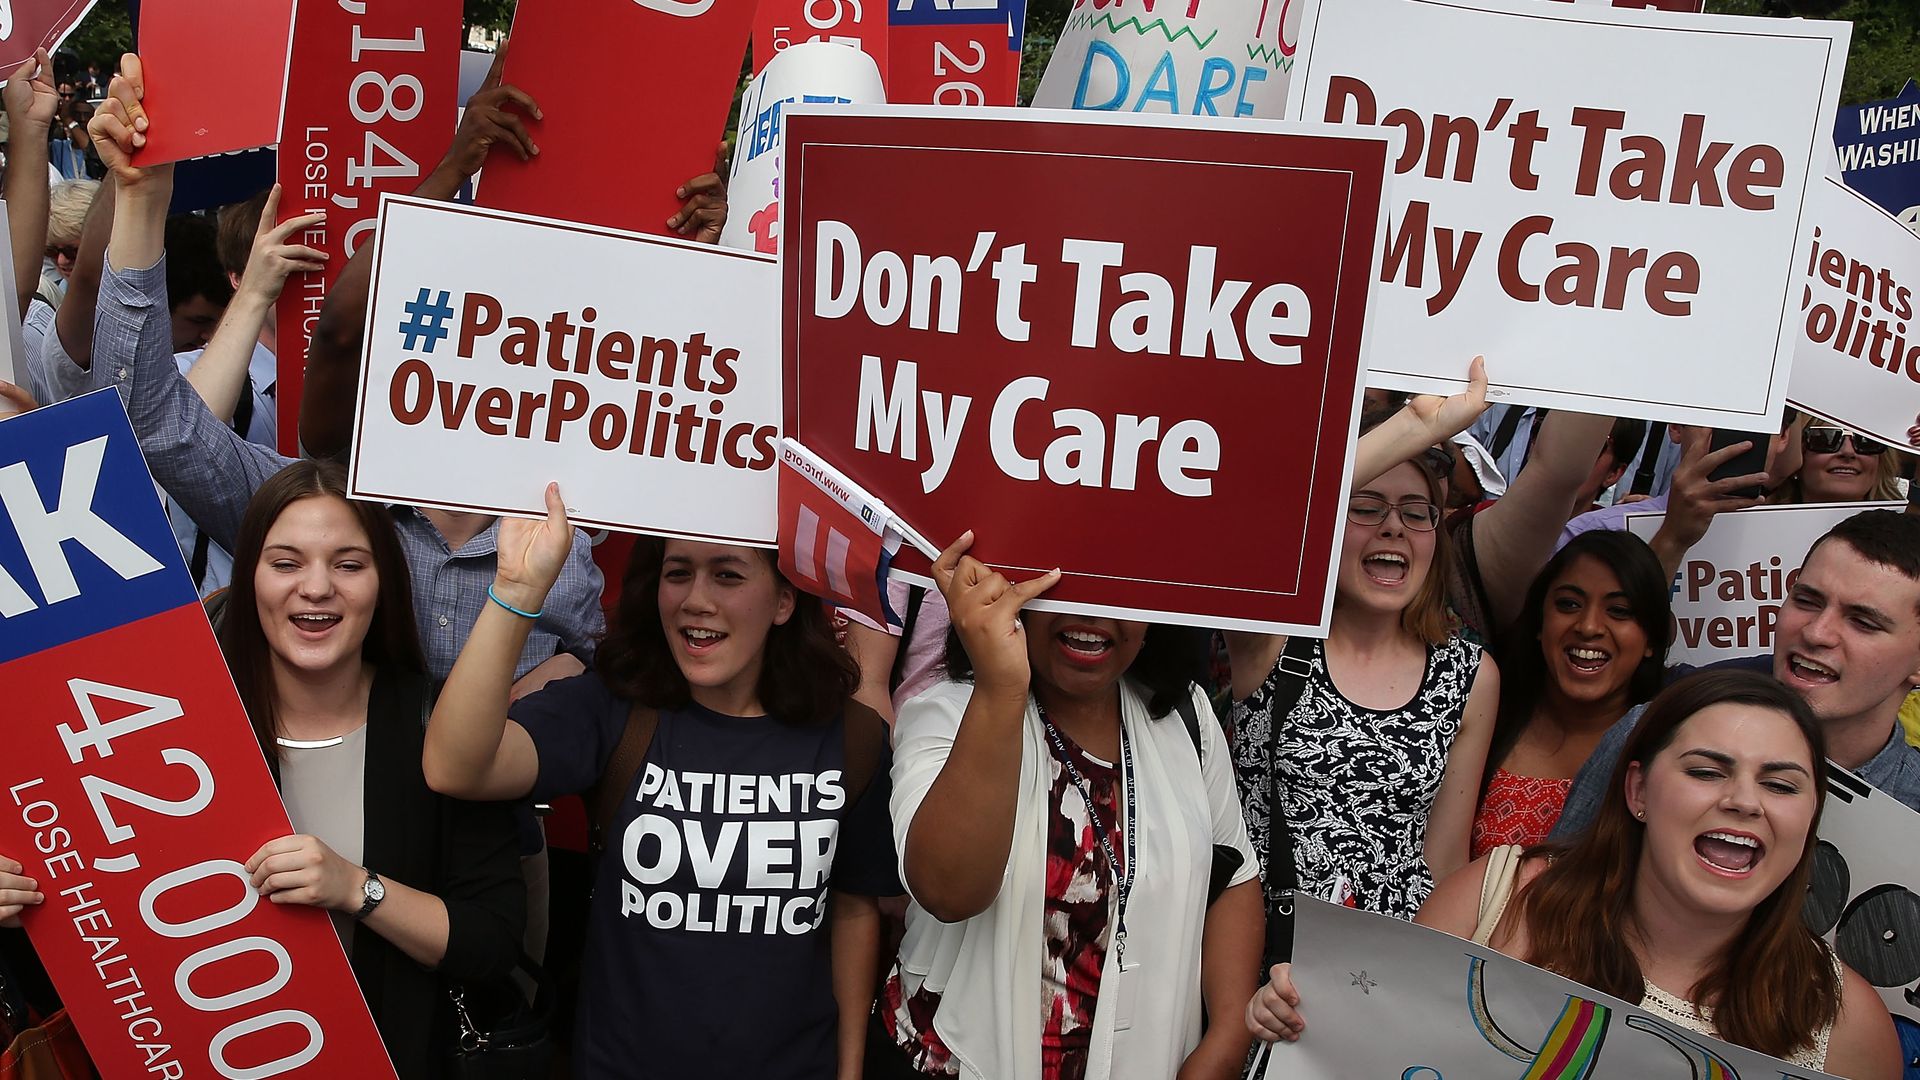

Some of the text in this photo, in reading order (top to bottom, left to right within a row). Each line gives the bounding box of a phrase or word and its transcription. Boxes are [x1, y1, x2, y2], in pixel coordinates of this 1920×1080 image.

[304, 126, 329, 199] LOSE
[1323, 75, 1785, 211] Don't Take
[1837, 138, 1920, 173] WASHI
[814, 220, 1038, 342] Don't
[1061, 238, 1312, 366] Take
[1380, 200, 1701, 317] My Care
[398, 287, 741, 395] #Patients
[1801, 282, 1920, 384] olitic
[388, 358, 779, 471] OverPolitics
[855, 354, 1221, 498] My Care
[0, 434, 166, 619] K
[9, 777, 85, 879] LOSE
[636, 762, 846, 814] PATIENTS
[56, 677, 324, 1080] 42,000
[622, 813, 839, 889] OVER
[621, 878, 828, 935] POLITICS
